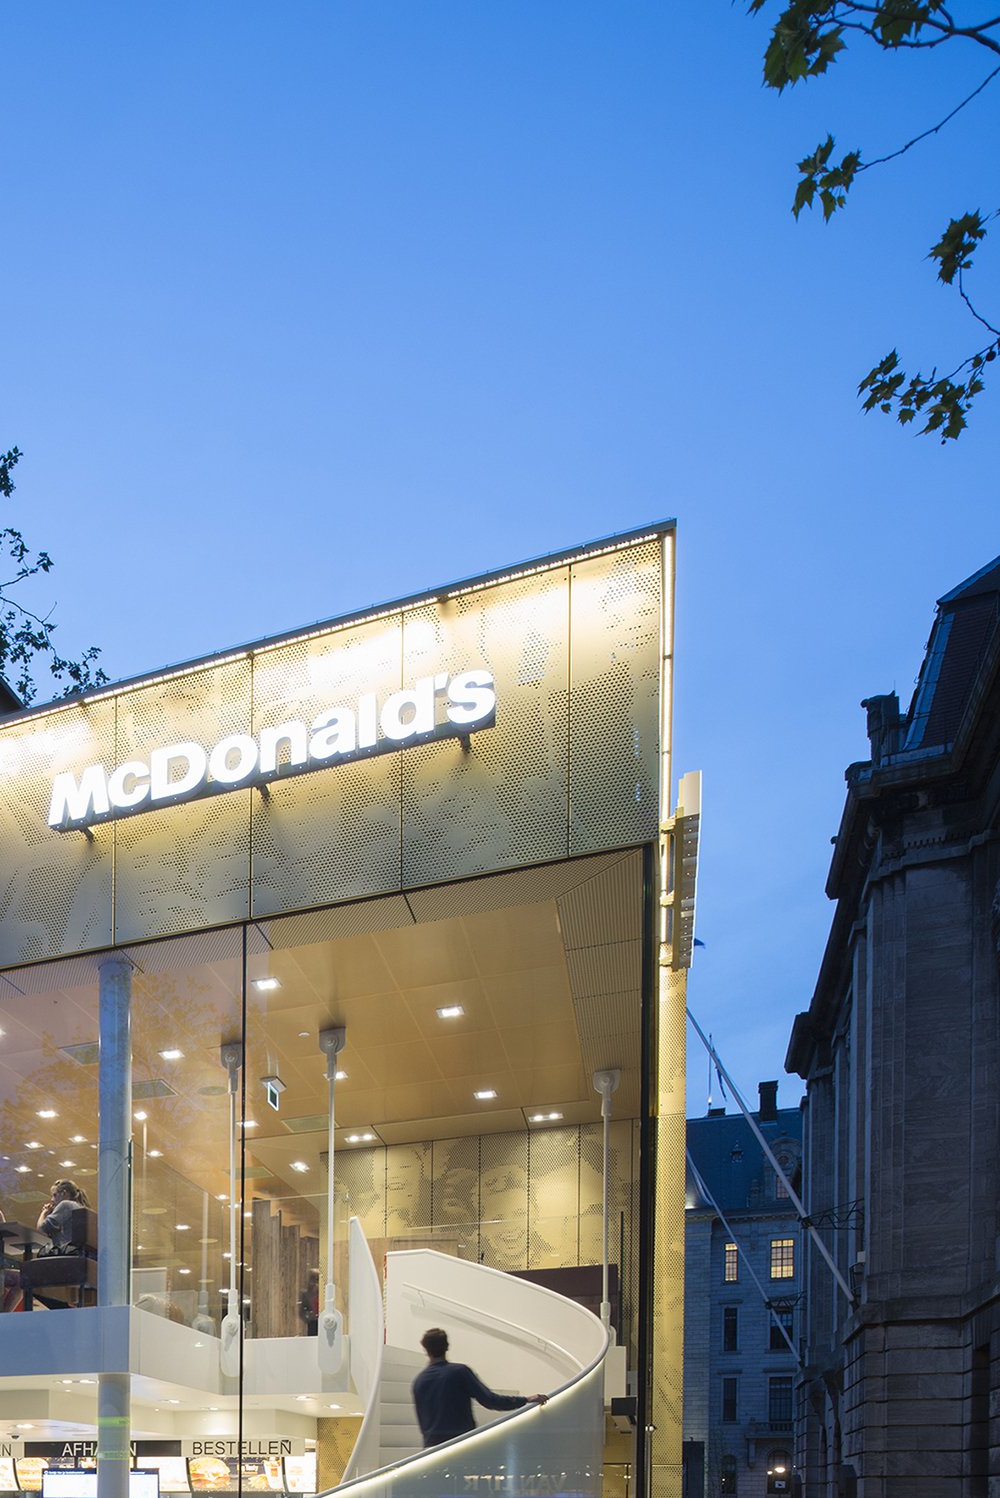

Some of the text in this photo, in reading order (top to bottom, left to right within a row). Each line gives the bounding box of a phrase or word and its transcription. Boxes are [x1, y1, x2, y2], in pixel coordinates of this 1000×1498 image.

[48, 669, 496, 829] McDonald's
[61, 1442, 136, 1456] AFHN
[192, 1441, 292, 1455] BESTELLEN
